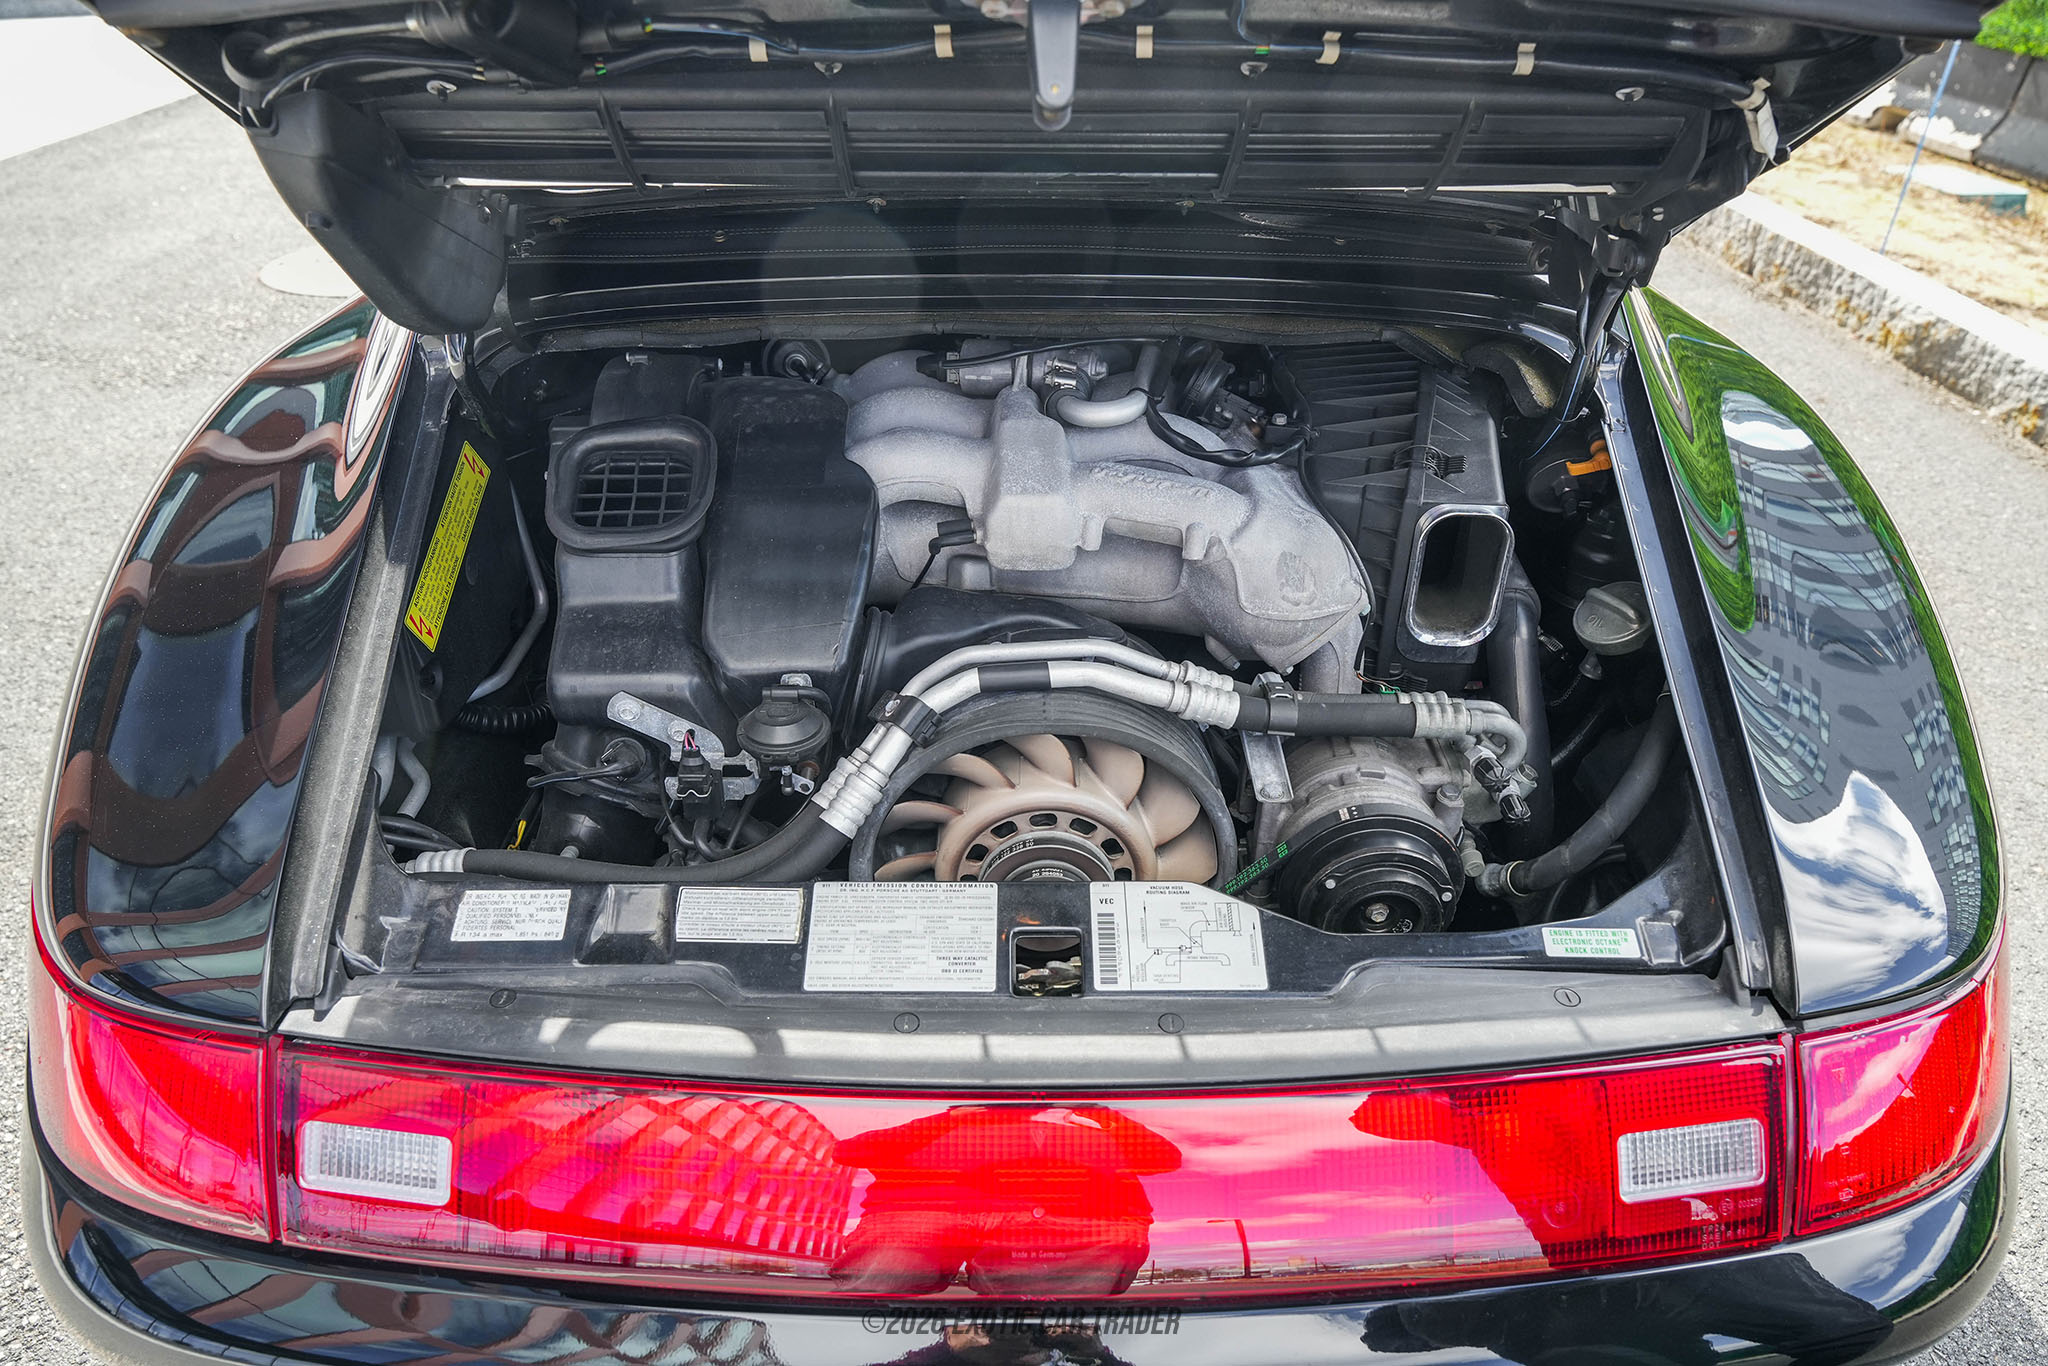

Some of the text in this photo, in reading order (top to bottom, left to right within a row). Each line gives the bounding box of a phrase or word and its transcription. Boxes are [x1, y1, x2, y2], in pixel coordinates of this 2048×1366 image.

[440, 501, 452, 528] ATTENTION
[456, 462, 465, 482] TENSION
[414, 581, 426, 608] ACHTUNG
[1702, 1232, 1720, 1242] SAE
[1702, 1241, 1720, 1249] DOT
[1039, 1250, 1066, 1258] Germany
